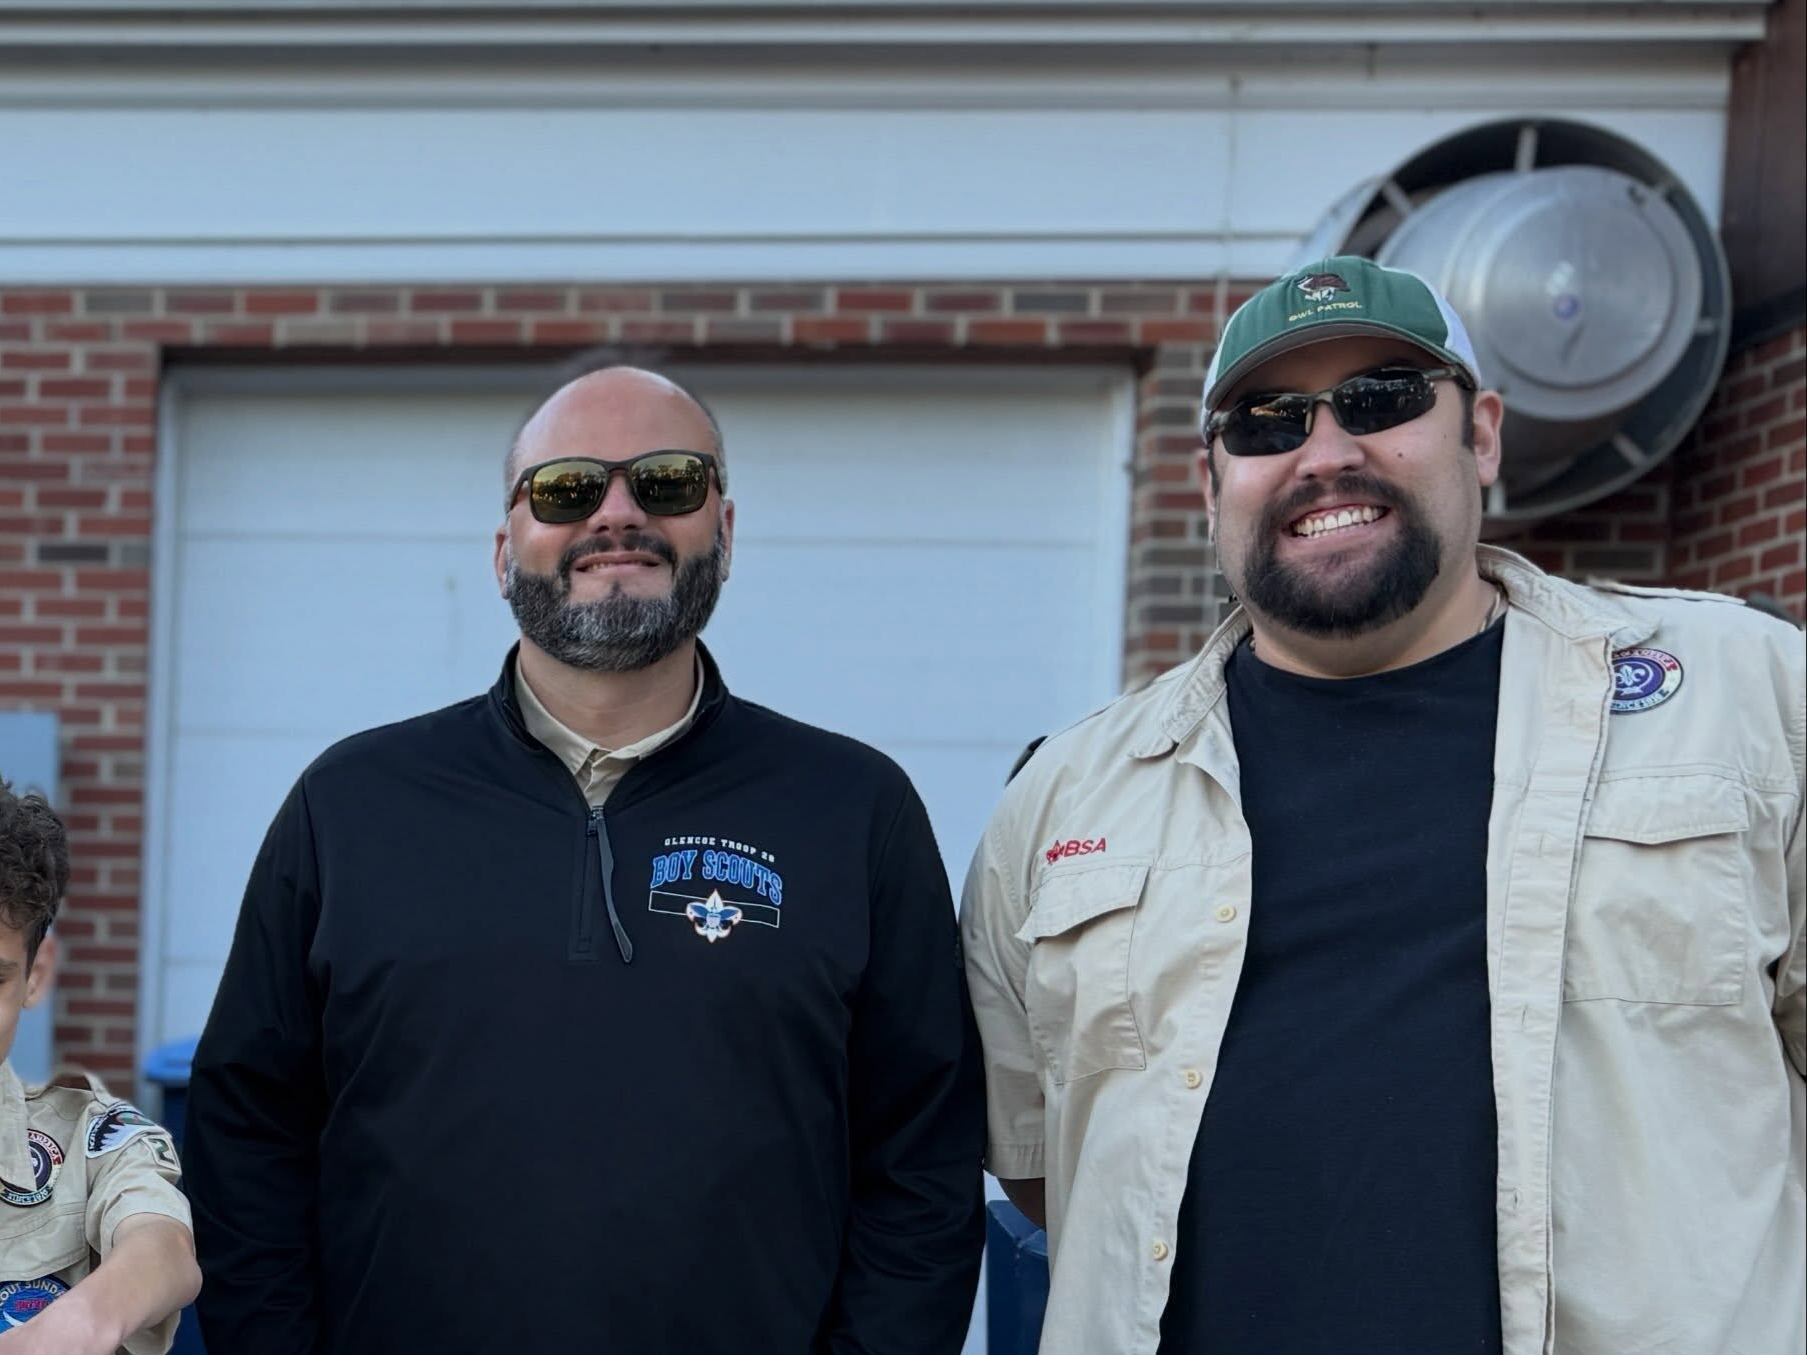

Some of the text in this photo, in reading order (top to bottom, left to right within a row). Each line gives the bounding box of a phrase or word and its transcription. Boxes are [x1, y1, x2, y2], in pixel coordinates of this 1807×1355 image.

[1288, 301, 1362, 322] OWL PATROL
[664, 836, 775, 863] GLENCOE TROOP 28
[1064, 837, 1107, 857] BSA
[650, 849, 783, 905] BOY SCOUTS
